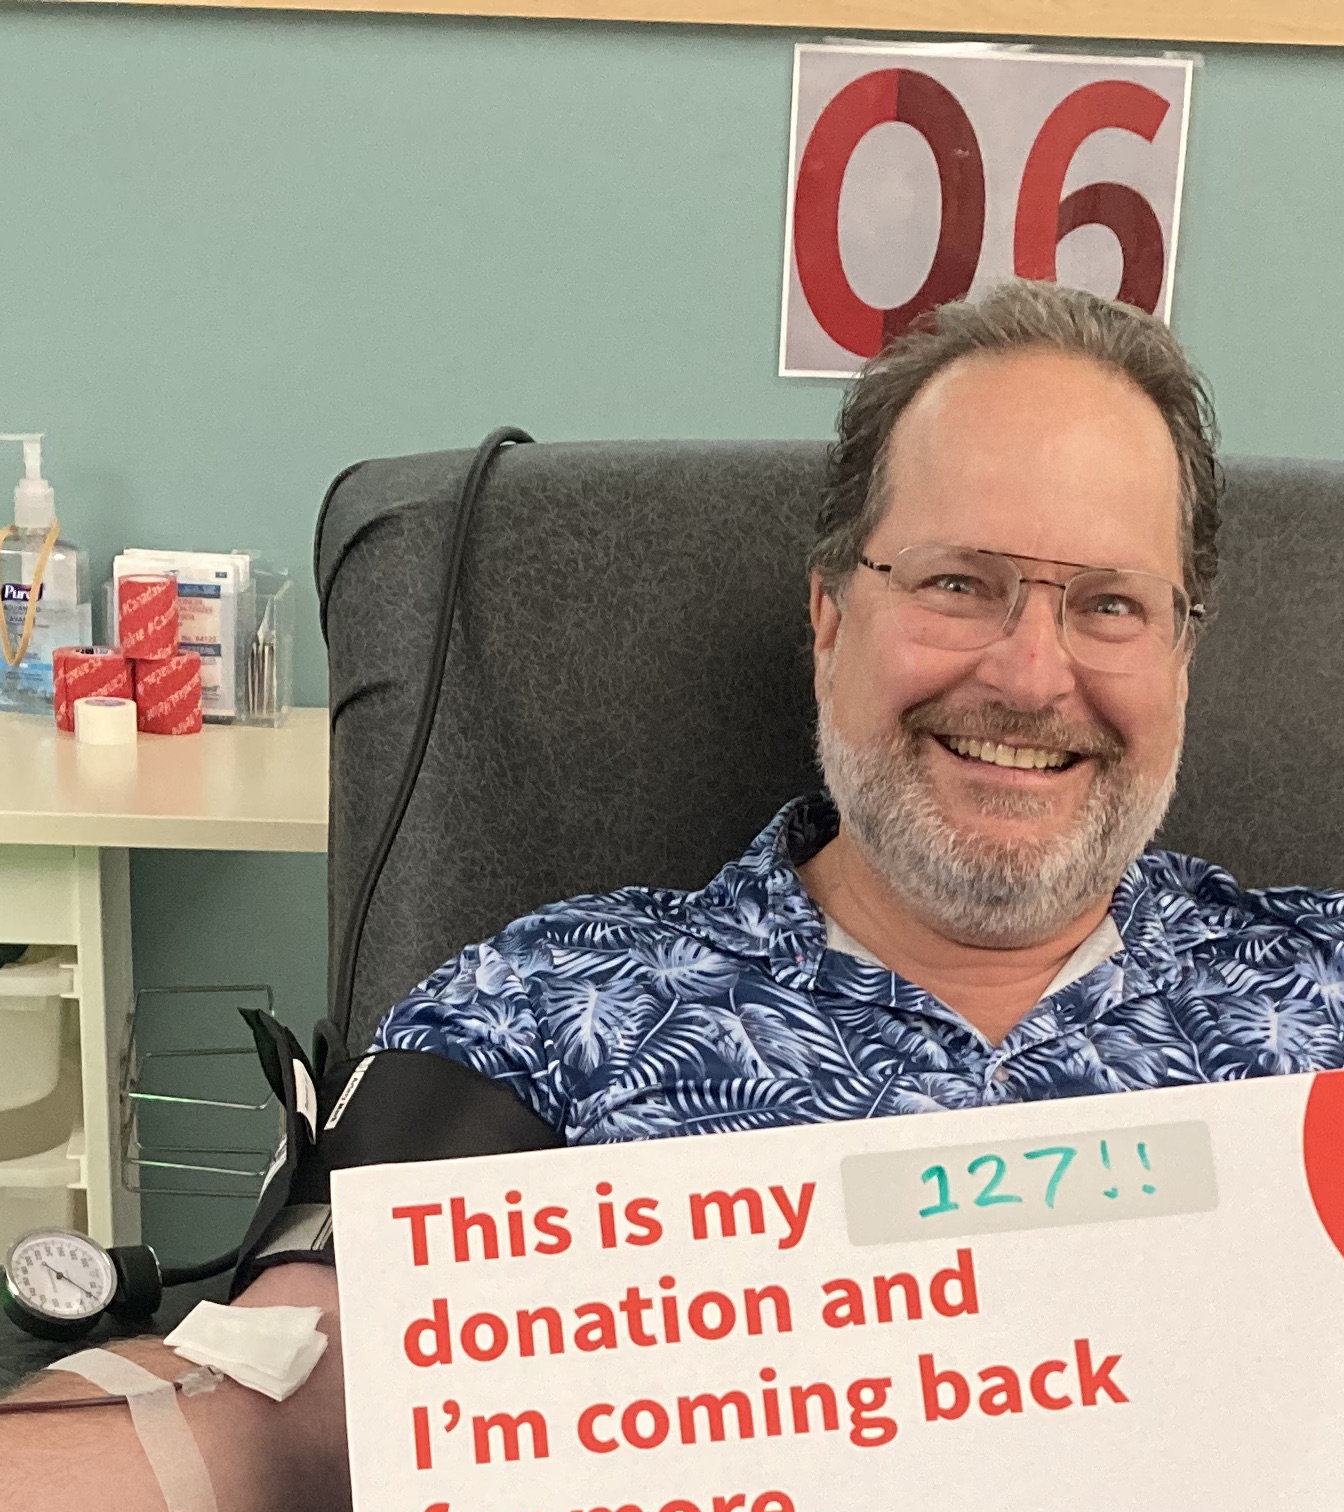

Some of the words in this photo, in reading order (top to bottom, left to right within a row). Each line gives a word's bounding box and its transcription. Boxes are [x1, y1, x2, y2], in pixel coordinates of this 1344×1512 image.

[796, 67, 1170, 359] 06
[392, 1190, 572, 1266] This
[596, 1182, 663, 1248] is
[689, 1182, 815, 1250] my
[919, 1140, 1155, 1218] 127!!
[404, 1275, 792, 1368] donation
[822, 1248, 978, 1328] and
[413, 1400, 549, 1470] I'm
[577, 1368, 898, 1454] coming
[919, 1338, 1129, 1421] back
